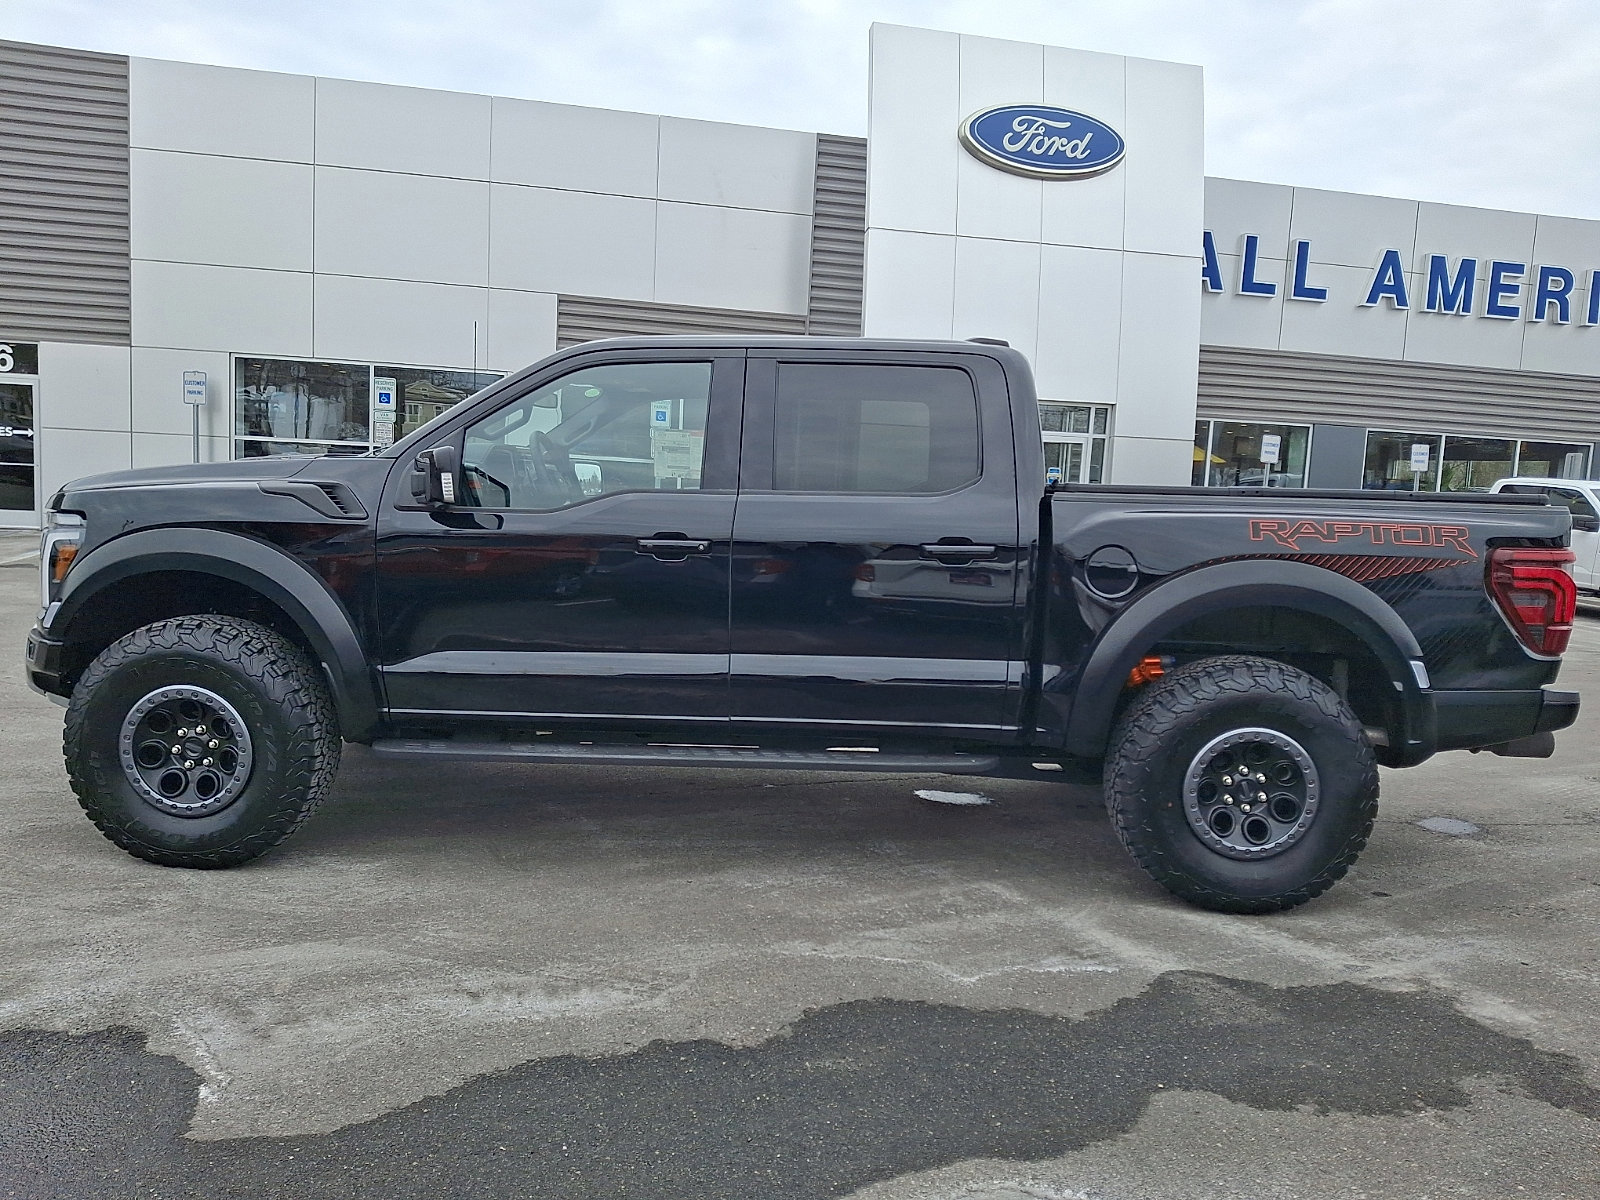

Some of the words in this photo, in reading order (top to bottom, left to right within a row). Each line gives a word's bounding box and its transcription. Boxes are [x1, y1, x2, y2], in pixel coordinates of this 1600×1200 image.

[1003, 115, 1093, 159] Ford
[1360, 248, 1600, 326] AMERI
[1250, 519, 1478, 558] RAPTOR
